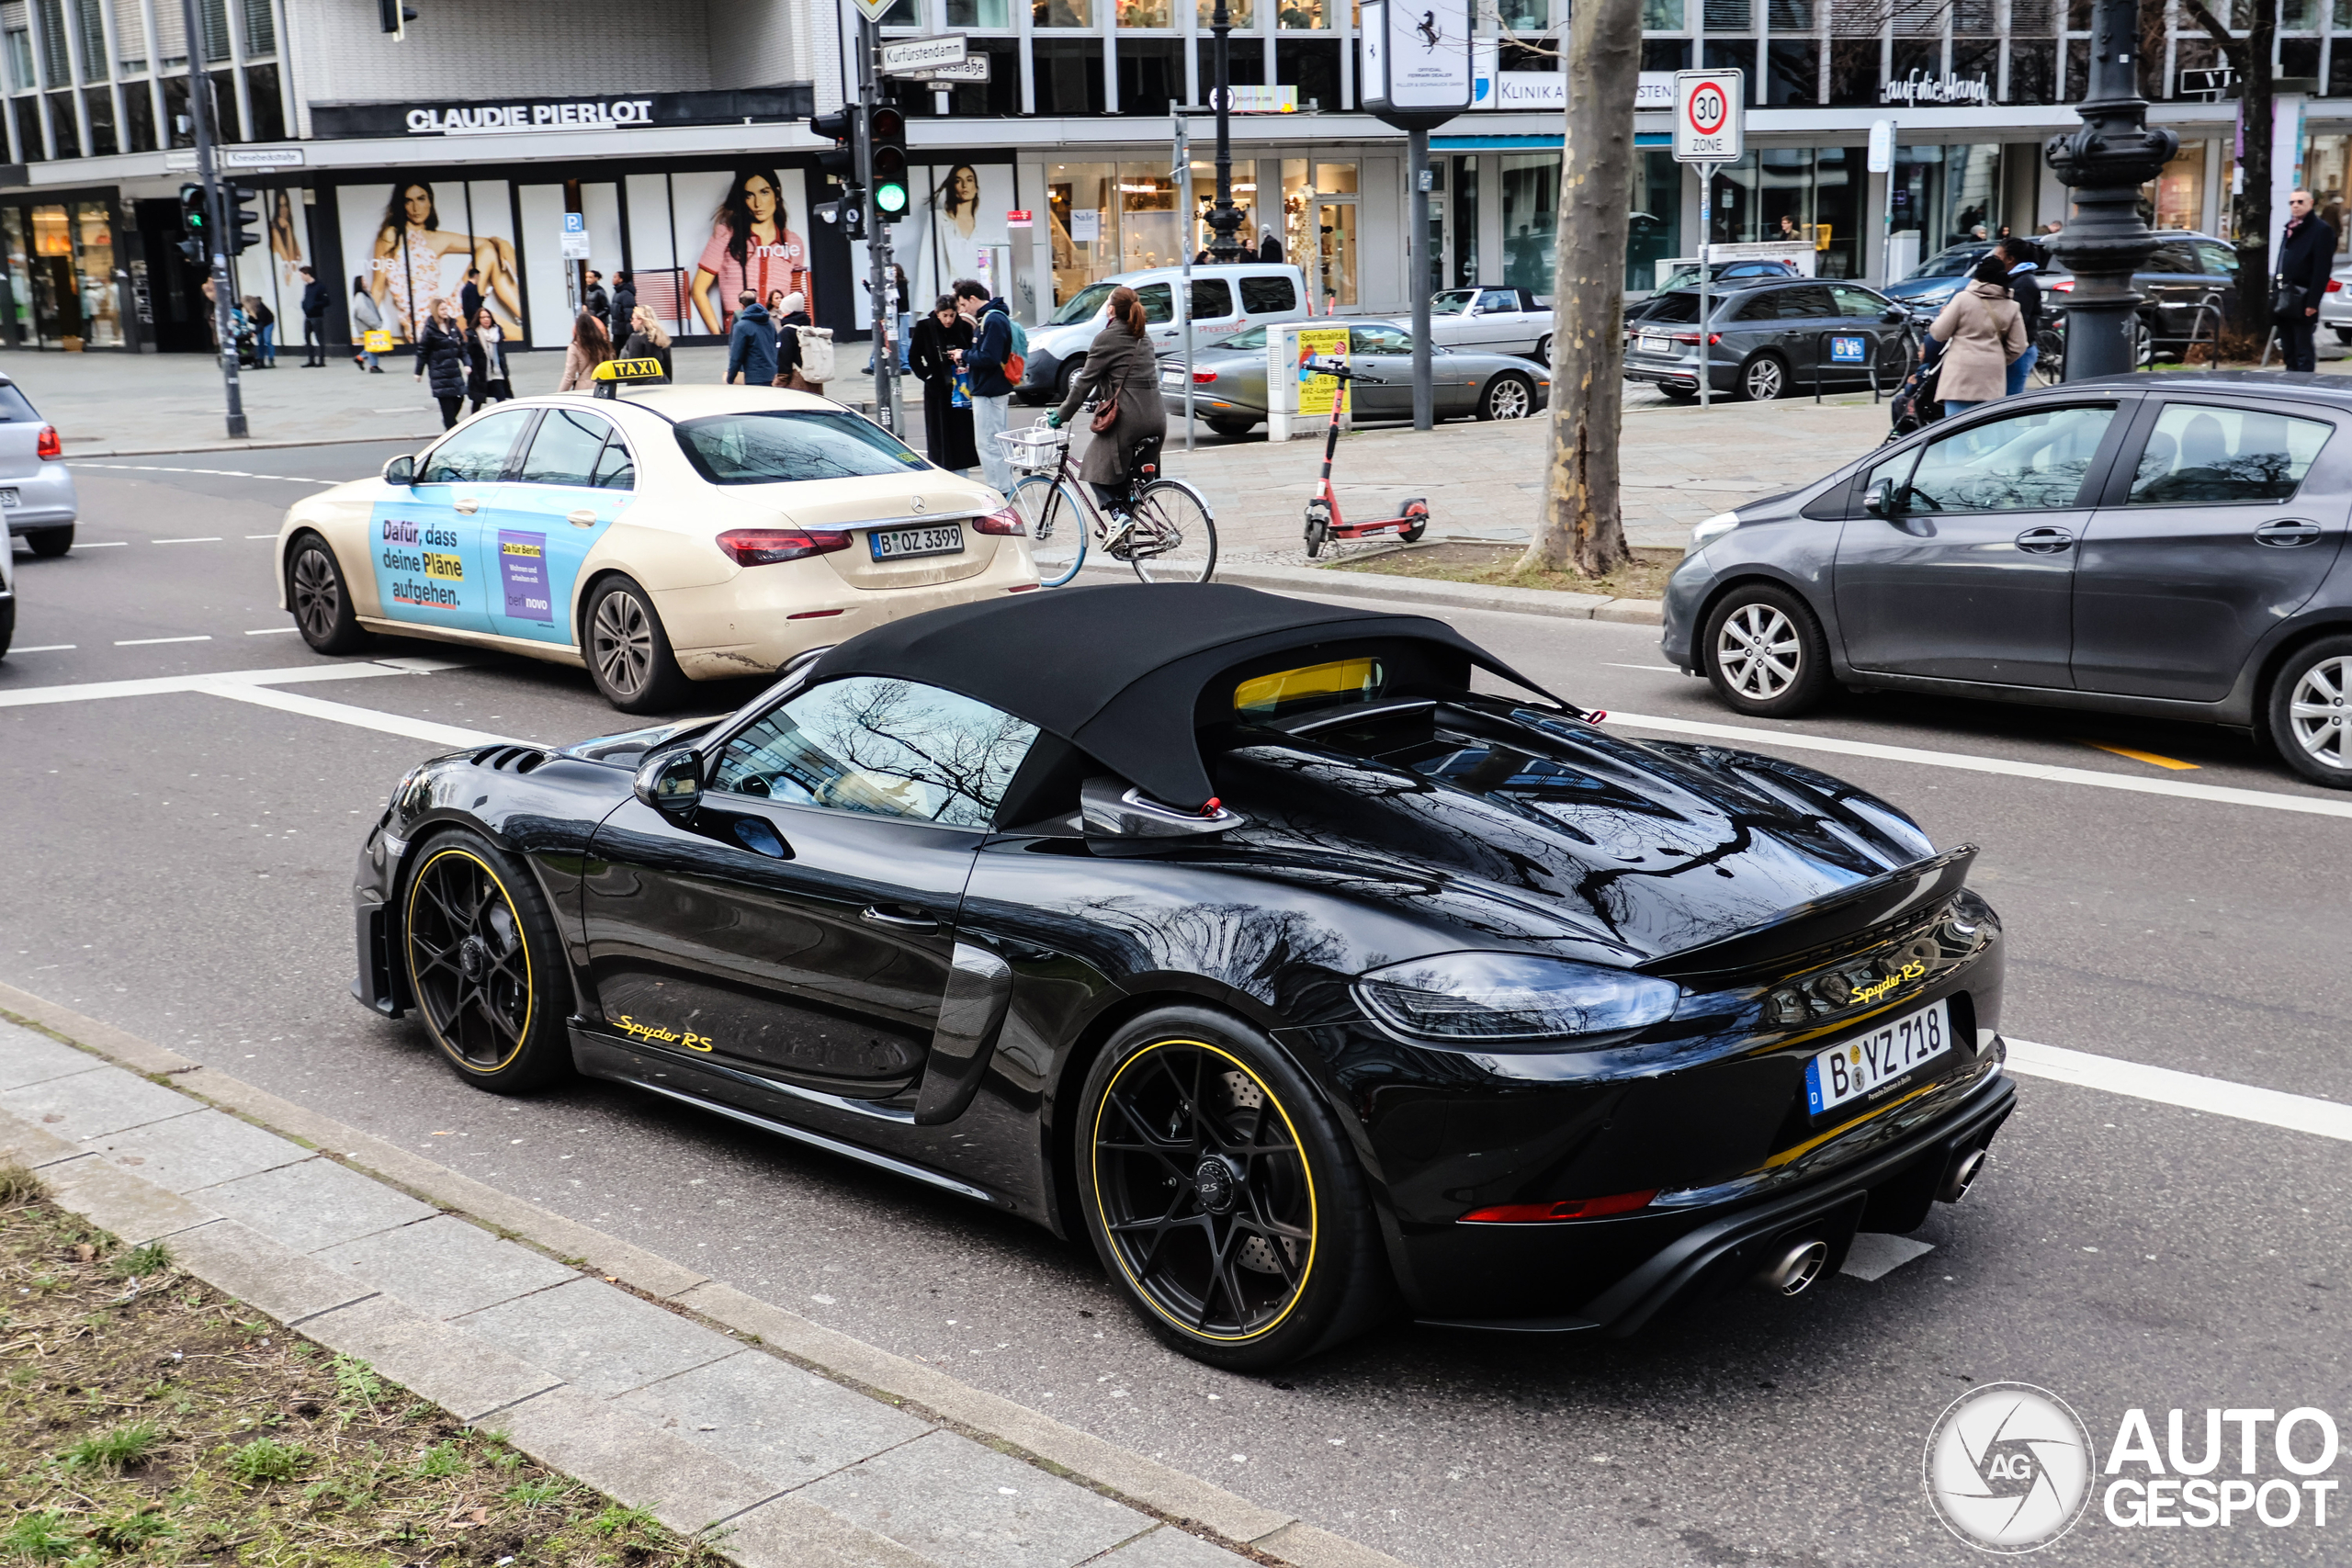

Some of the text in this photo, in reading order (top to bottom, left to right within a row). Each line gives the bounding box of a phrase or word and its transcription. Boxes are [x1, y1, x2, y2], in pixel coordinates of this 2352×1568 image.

[887, 44, 961, 63] Kurfürstendamm
[406, 101, 652, 130] CLAUDIE PIERLOT
[1696, 96, 1719, 120] 30
[1692, 139, 1723, 152] ZONE
[1074, 212, 1094, 221] Sale
[757, 242, 800, 260] maje
[1301, 333, 1346, 343] Spiritualität
[615, 361, 655, 376] TAXI
[383, 520, 458, 547] Dafür, dass
[881, 536, 891, 553] B
[902, 533, 922, 551] OZ
[924, 528, 959, 548] 3399
[383, 547, 463, 577] deine Pläne
[522, 545, 541, 556] Berlin
[393, 579, 461, 606] aufgehen.
[1849, 960, 1926, 1003] Spyder RS
[613, 1015, 713, 1052] Spyder RS
[1829, 1052, 1849, 1099] B
[1863, 1029, 1897, 1081] YZ
[1899, 1009, 1940, 1065] 718
[1201, 1182, 1217, 1193] RS
